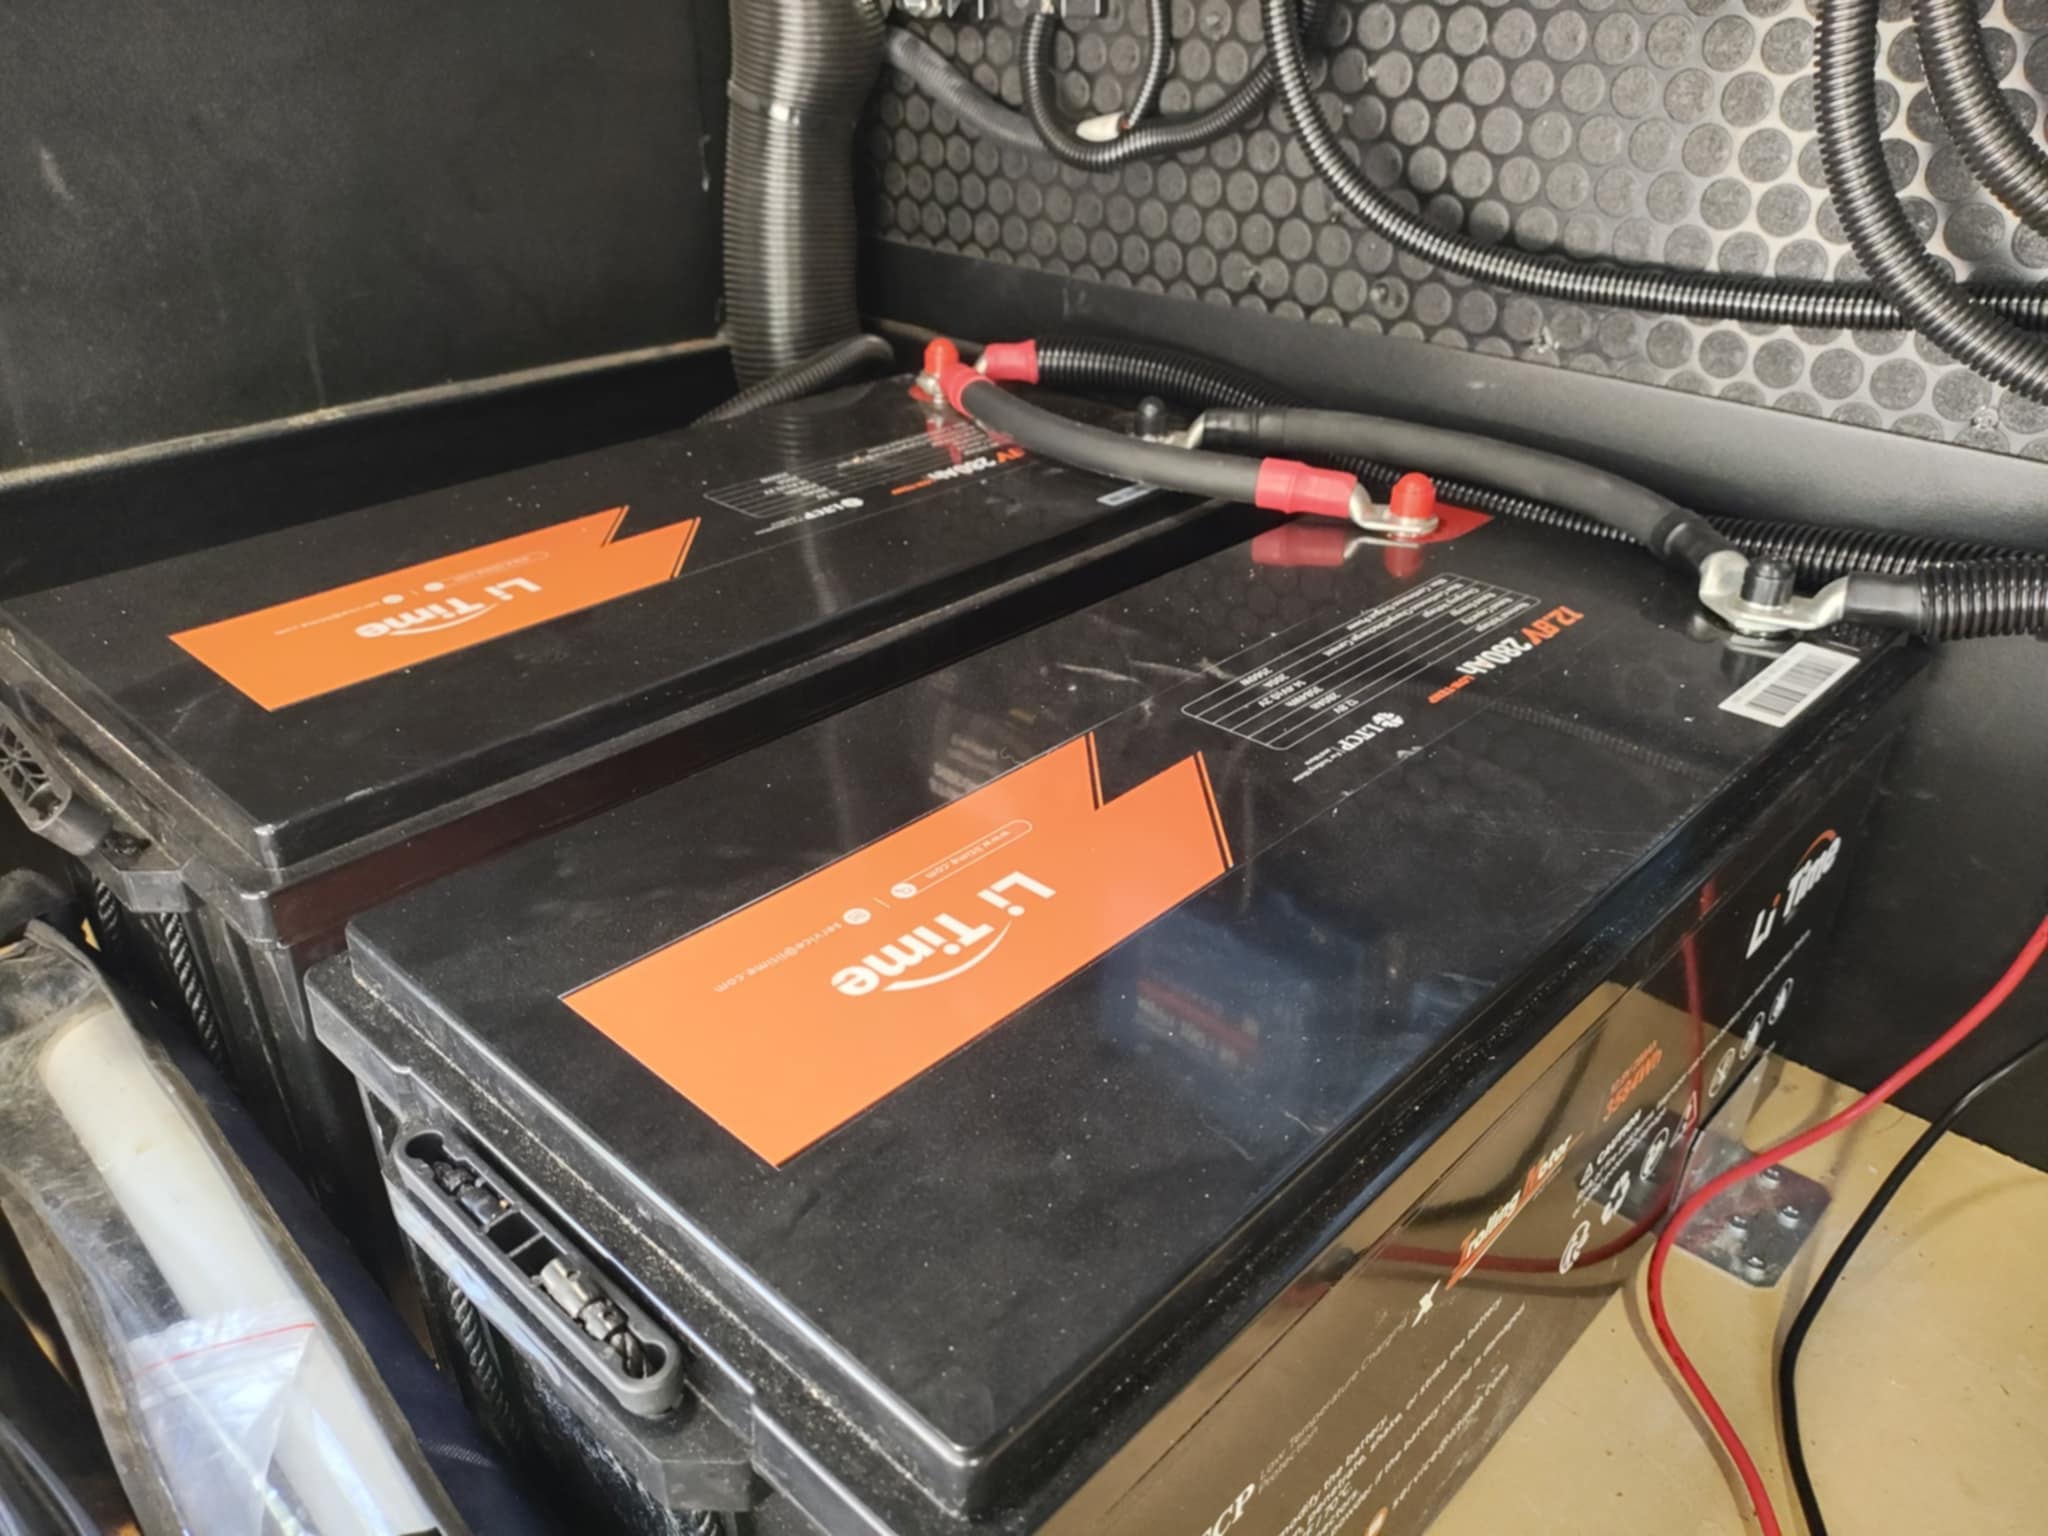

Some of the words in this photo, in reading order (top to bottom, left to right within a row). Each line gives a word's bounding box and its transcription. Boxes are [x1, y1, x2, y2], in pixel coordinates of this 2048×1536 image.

[485, 577, 541, 600] Li
[356, 598, 487, 637] Time
[1522, 606, 1584, 645] 12.8V
[1456, 637, 1533, 675] 280Ah
[1338, 721, 1384, 752] LTCP
[978, 872, 1055, 916] Li
[1746, 894, 1779, 958] Li
[832, 914, 994, 996] Time
[1459, 1190, 1520, 1267] Trolling
[1450, 1339, 1465, 1360] the
[1289, 1371, 1359, 1448] Temperature
[1324, 1466, 1343, 1490] the
[1385, 1451, 1401, 1473] the
